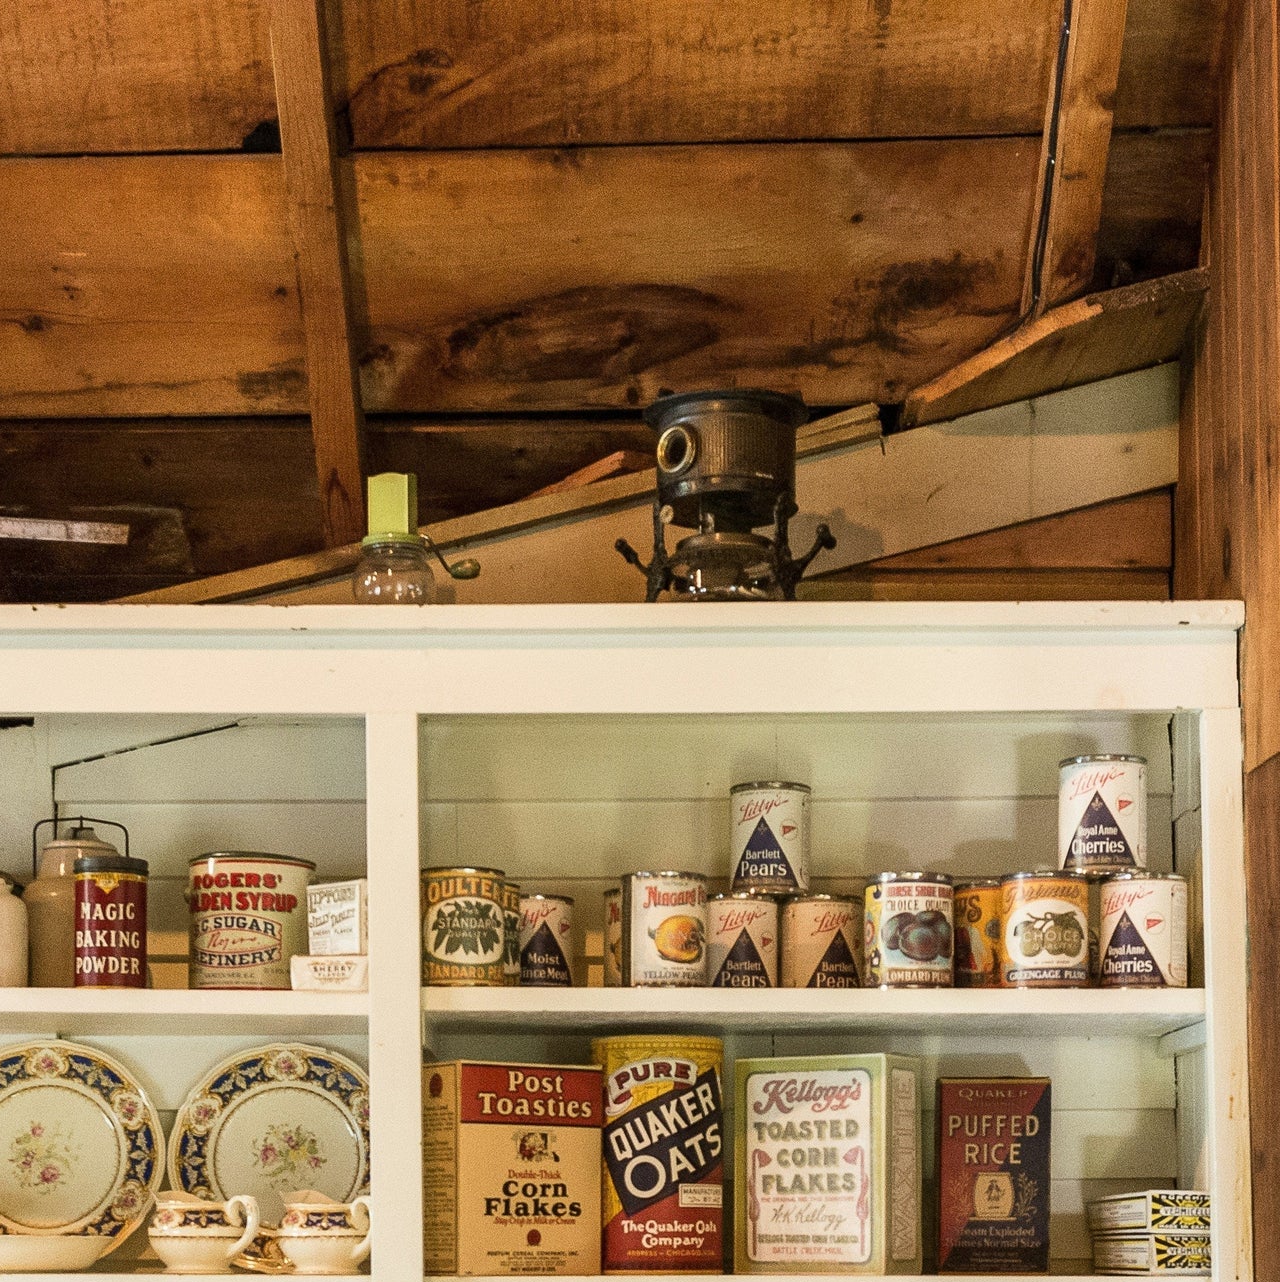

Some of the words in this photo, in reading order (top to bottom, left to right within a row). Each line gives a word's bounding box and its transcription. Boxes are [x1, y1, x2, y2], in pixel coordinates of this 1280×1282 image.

[1098, 824, 1118, 836] Anne
[745, 849, 781, 860] Bartlett
[1071, 838, 1125, 855] Cherries
[741, 860, 787, 877] Pears
[80, 902, 136, 921] MAGIC
[236, 891, 298, 914] SYRUP
[213, 916, 277, 937] SUGAR
[76, 930, 140, 949] BAKING
[1126, 944, 1146, 955] Anne
[76, 956, 140, 975] POWDER
[1104, 957, 1153, 974] Cherries
[721, 972, 767, 987] Pears
[507, 1070, 564, 1094] Post
[613, 1061, 692, 1090] PURE
[478, 1092, 592, 1118] Toasties
[753, 1077, 862, 1115] Kellogg's
[609, 1082, 716, 1162] QUAKER
[753, 1119, 860, 1143] TOASTED
[948, 1114, 1040, 1137] PUFFED
[623, 1123, 722, 1199] OATS
[776, 1147, 839, 1169] CORN
[964, 1143, 1022, 1165] RICE
[761, 1172, 856, 1195] FLAKES
[483, 1197, 582, 1217] Flakes
[621, 1219, 645, 1234] The
[645, 1219, 694, 1235] Quaker
[641, 1233, 705, 1249] Company
